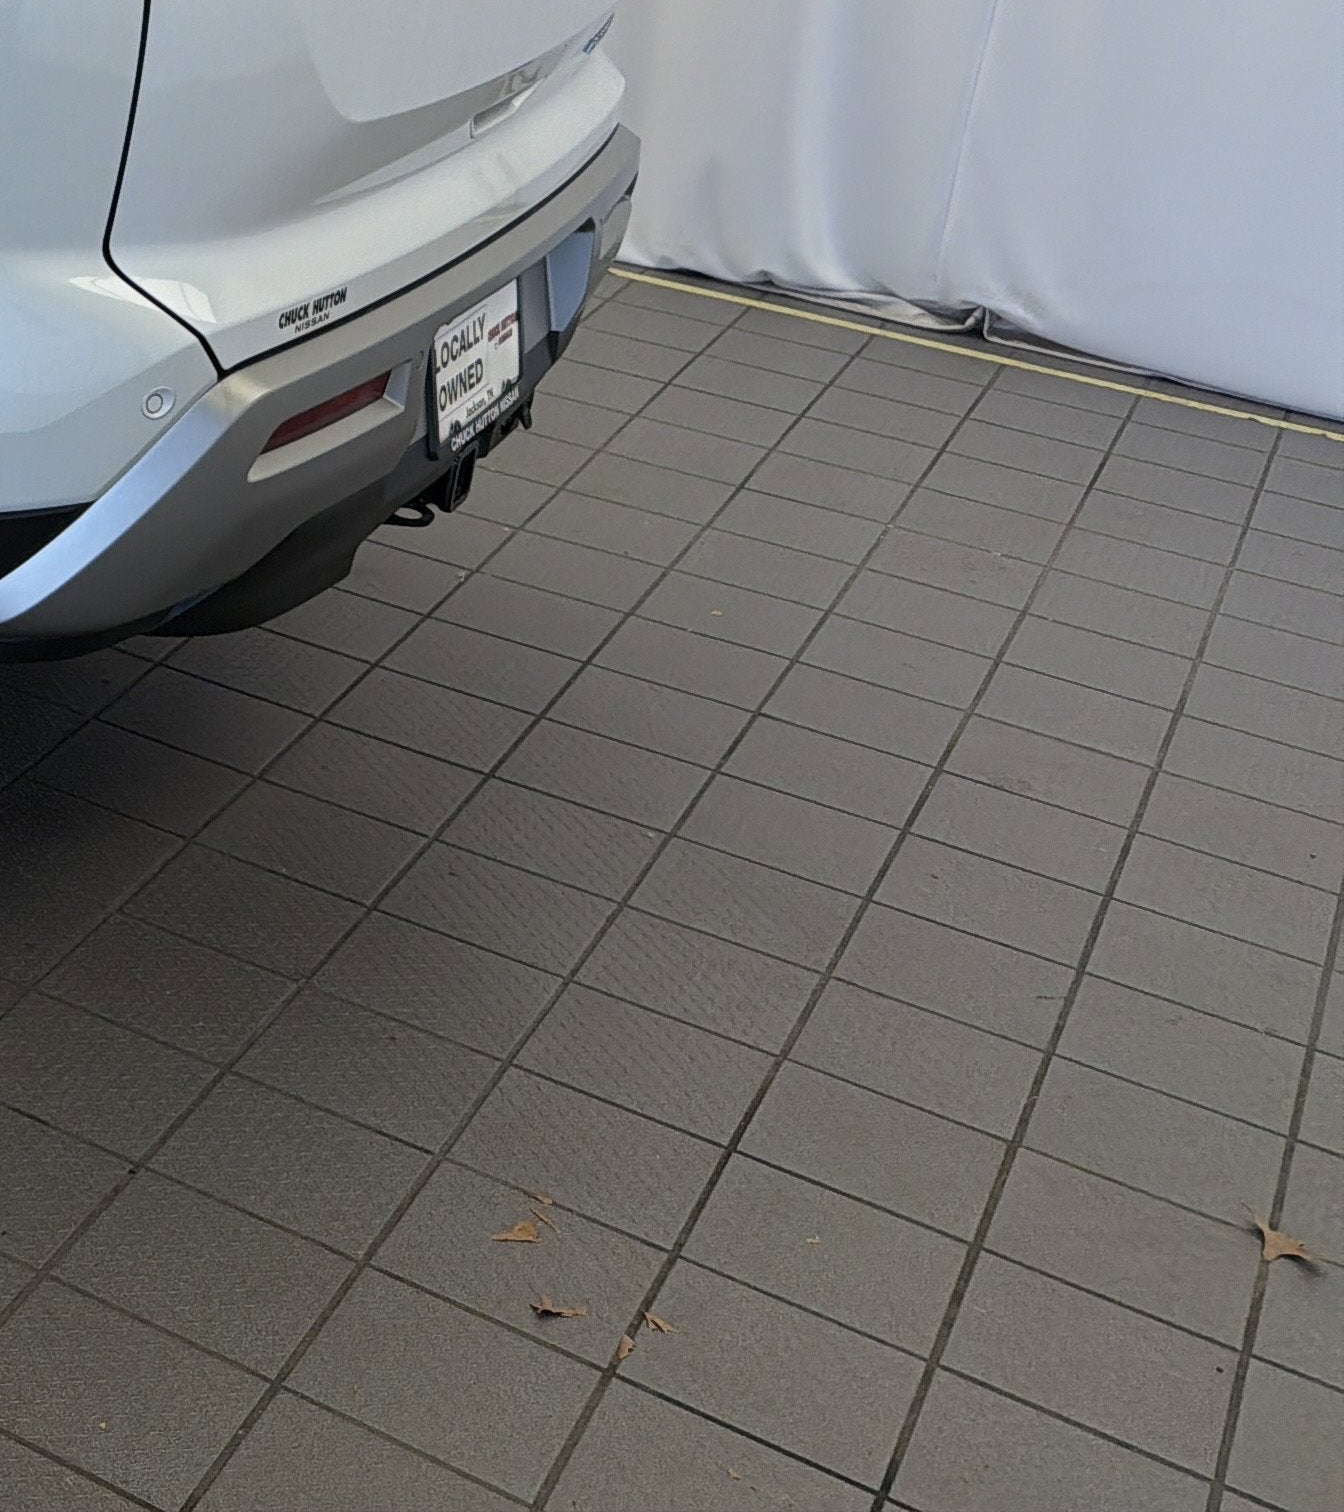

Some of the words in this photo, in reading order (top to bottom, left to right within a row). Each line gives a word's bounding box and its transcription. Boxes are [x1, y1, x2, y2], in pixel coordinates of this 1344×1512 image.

[278, 302, 310, 330] CHUCK
[312, 286, 348, 317] HUTTON
[294, 311, 331, 334] NISSAN
[434, 312, 486, 374] LOCALLY
[438, 357, 484, 413] OWNED
